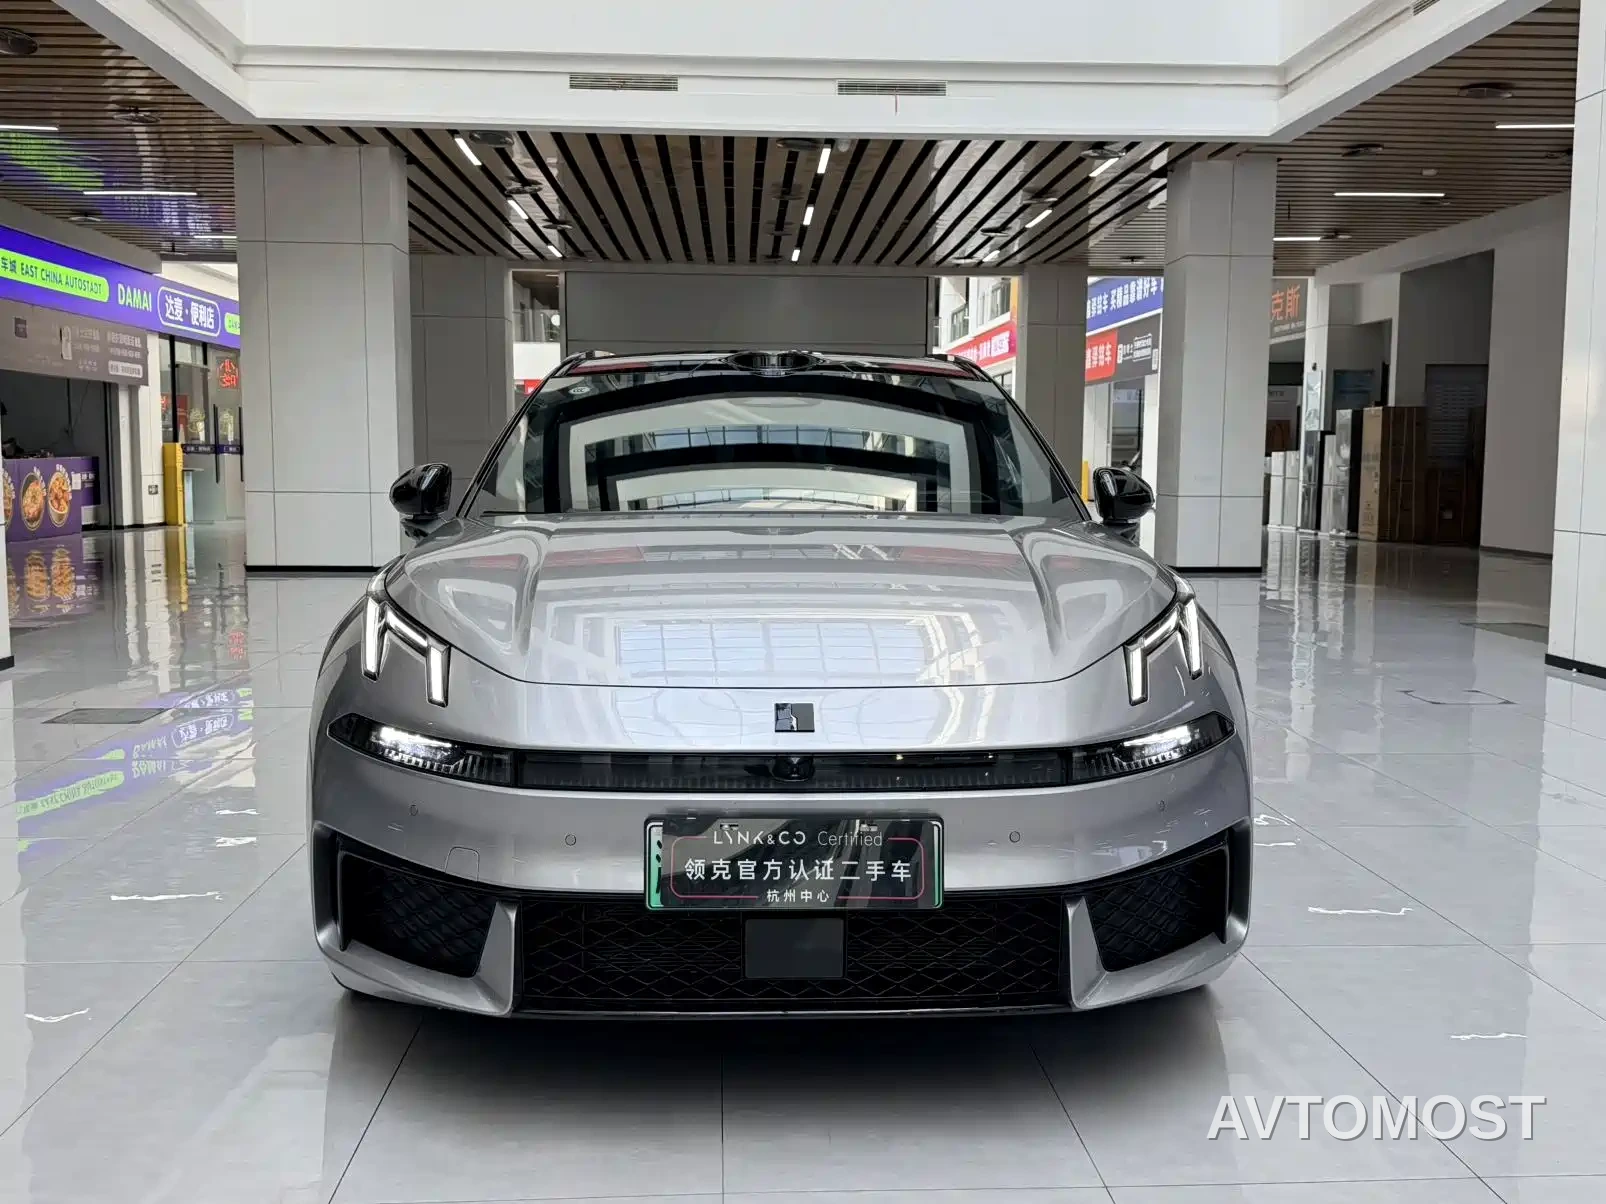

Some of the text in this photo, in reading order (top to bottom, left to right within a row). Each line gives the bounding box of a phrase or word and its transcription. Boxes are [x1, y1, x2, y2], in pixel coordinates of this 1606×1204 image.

[20, 262, 38, 280] EAST
[41, 268, 63, 286] CHINA
[65, 274, 102, 295] AUTOSTADT
[117, 283, 152, 312] DAMAI
[713, 831, 883, 847] LYNK&CO Certified
[684, 858, 912, 882] 领克官方认证二手车
[767, 889, 830, 903] 杭州中心
